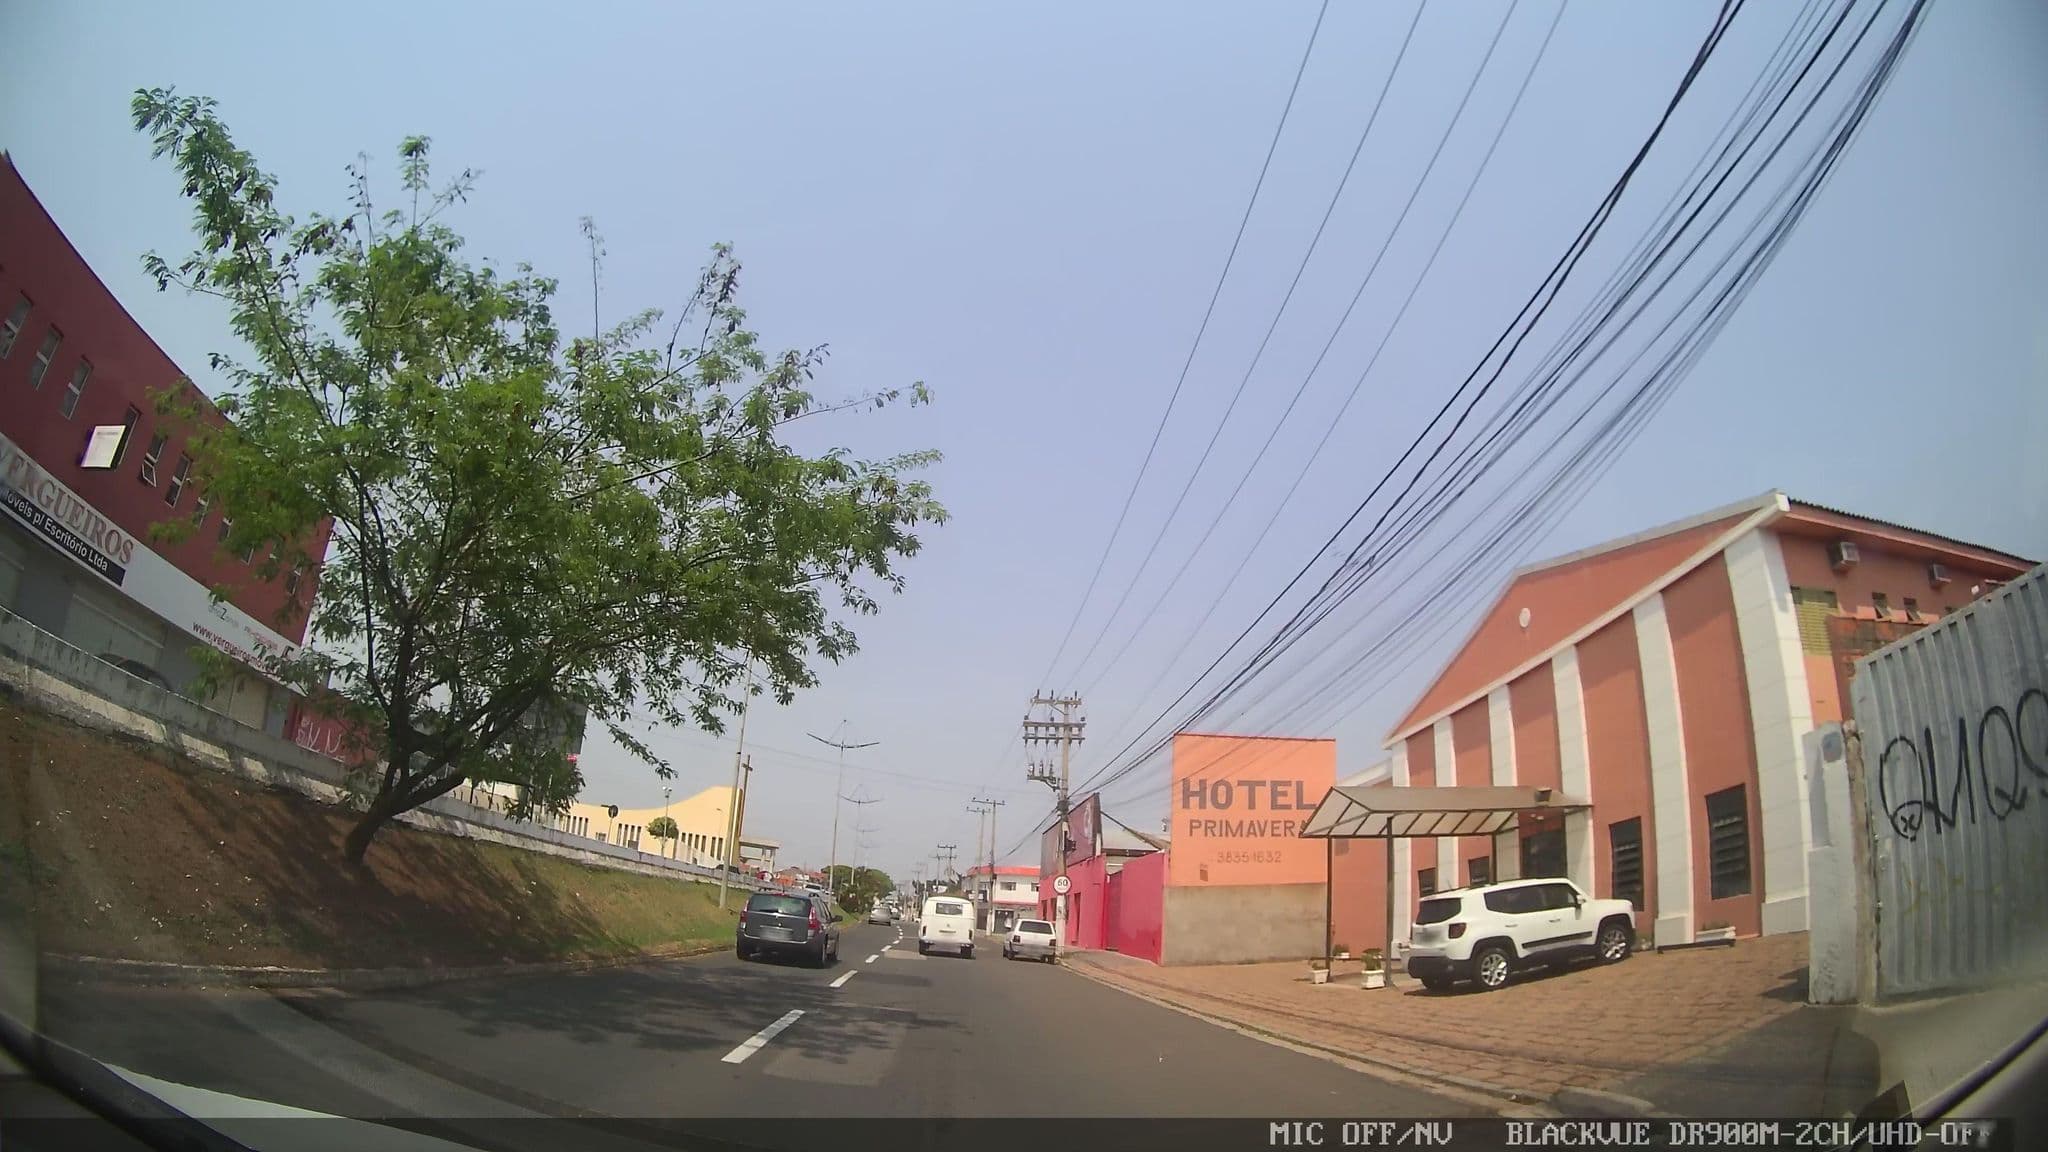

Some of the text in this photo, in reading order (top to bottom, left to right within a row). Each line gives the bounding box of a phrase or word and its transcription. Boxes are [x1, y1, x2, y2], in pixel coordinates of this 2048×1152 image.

[88, 553, 109, 572] Ltda
[1181, 777, 1318, 811] HOTEL
[1057, 878, 1069, 887] 60
